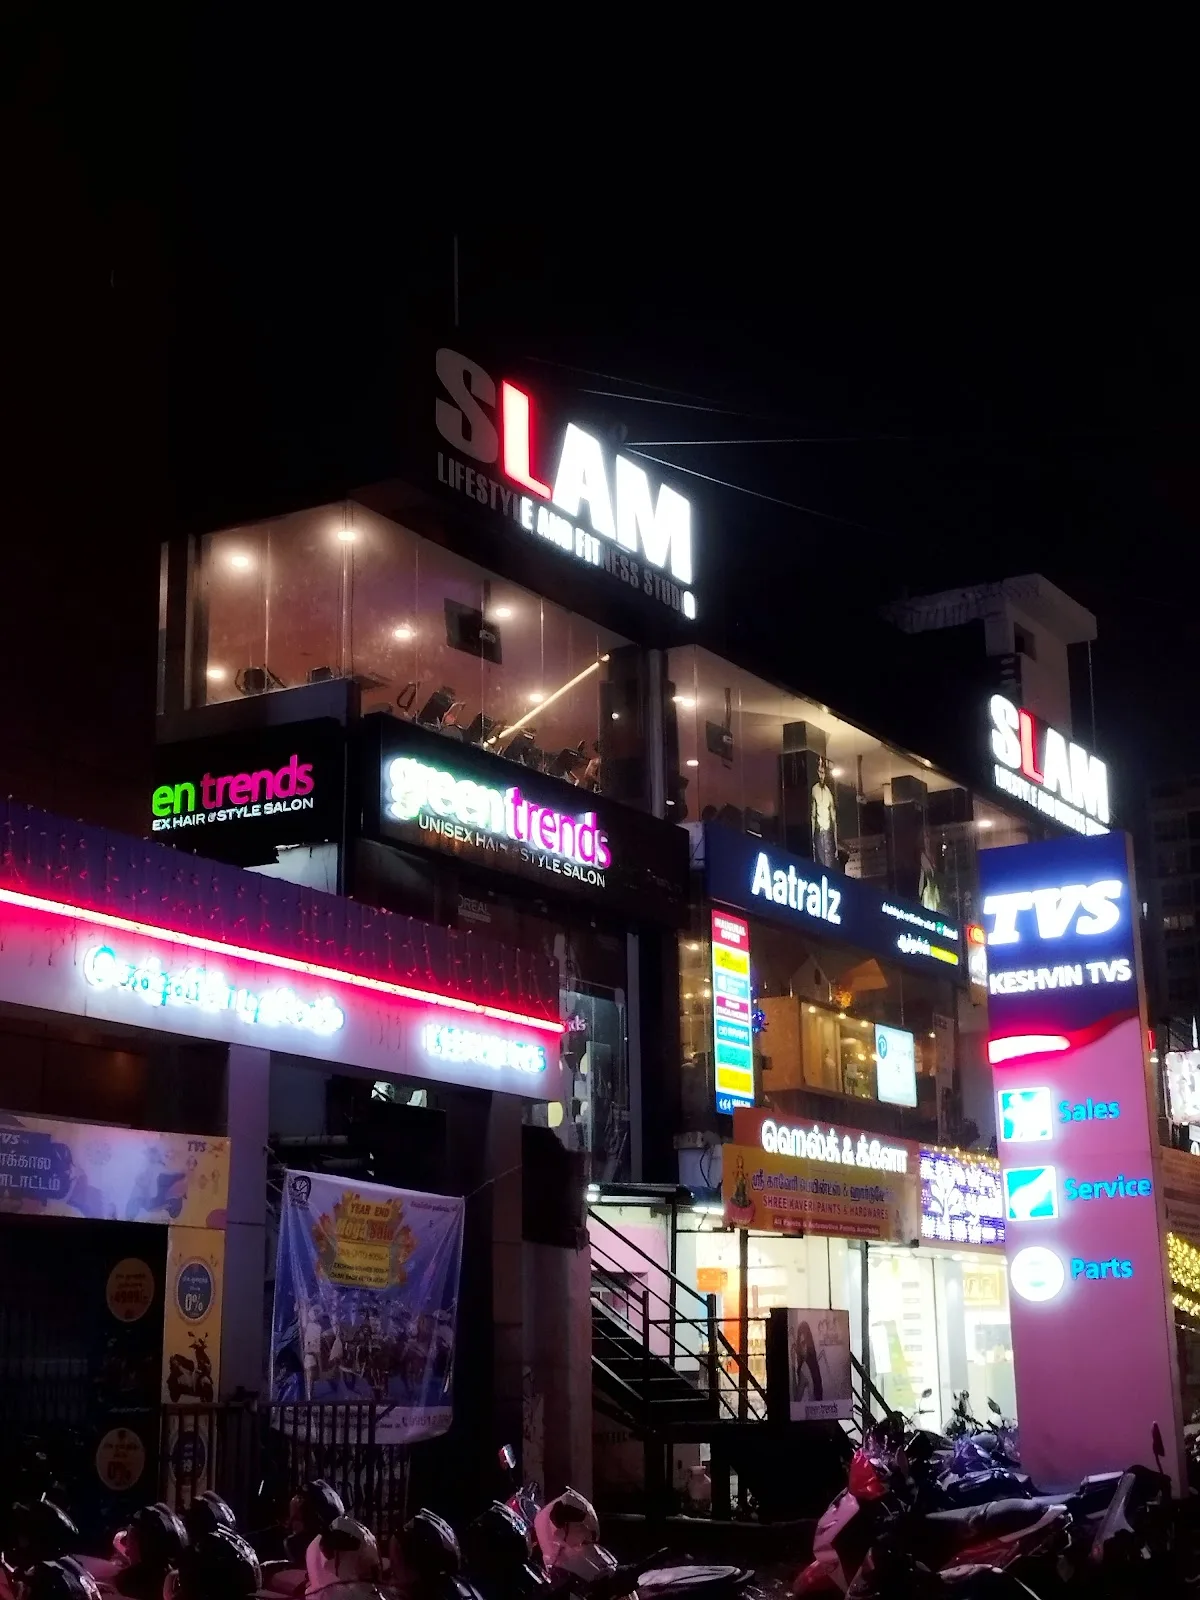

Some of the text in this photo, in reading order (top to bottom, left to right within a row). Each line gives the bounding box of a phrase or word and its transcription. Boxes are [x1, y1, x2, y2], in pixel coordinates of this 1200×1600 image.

[435, 347, 693, 586] SLAM
[437, 451, 533, 534] LIFESTYLE
[643, 568, 696, 620] STUDIO
[990, 693, 1110, 825] SLAM
[151, 754, 314, 817] en trends
[152, 818, 172, 831] EX
[172, 813, 206, 830] HAIR
[216, 805, 262, 822] STYLE
[264, 797, 314, 815] SALON
[389, 757, 611, 869] green trends
[418, 814, 473, 844] UNISEX
[520, 846, 561, 874] STYLE
[563, 858, 606, 888] SALON
[751, 852, 841, 925] Aatralz
[983, 879, 1123, 946] TVS
[989, 964, 1083, 995] KESHVIN
[1085, 959, 1133, 985] TVS
[1058, 1098, 1121, 1123] Sales
[350, 1203, 390, 1218] YEAR END
[762, 1195, 787, 1210] SHREE
[789, 1198, 815, 1213] KAVERI
[816, 1201, 841, 1216] PAINTS
[849, 1206, 889, 1220] HARDWARES
[1063, 1174, 1152, 1202] Service
[1070, 1257, 1134, 1280] Parts
[185, 1293, 204, 1312] 0%
